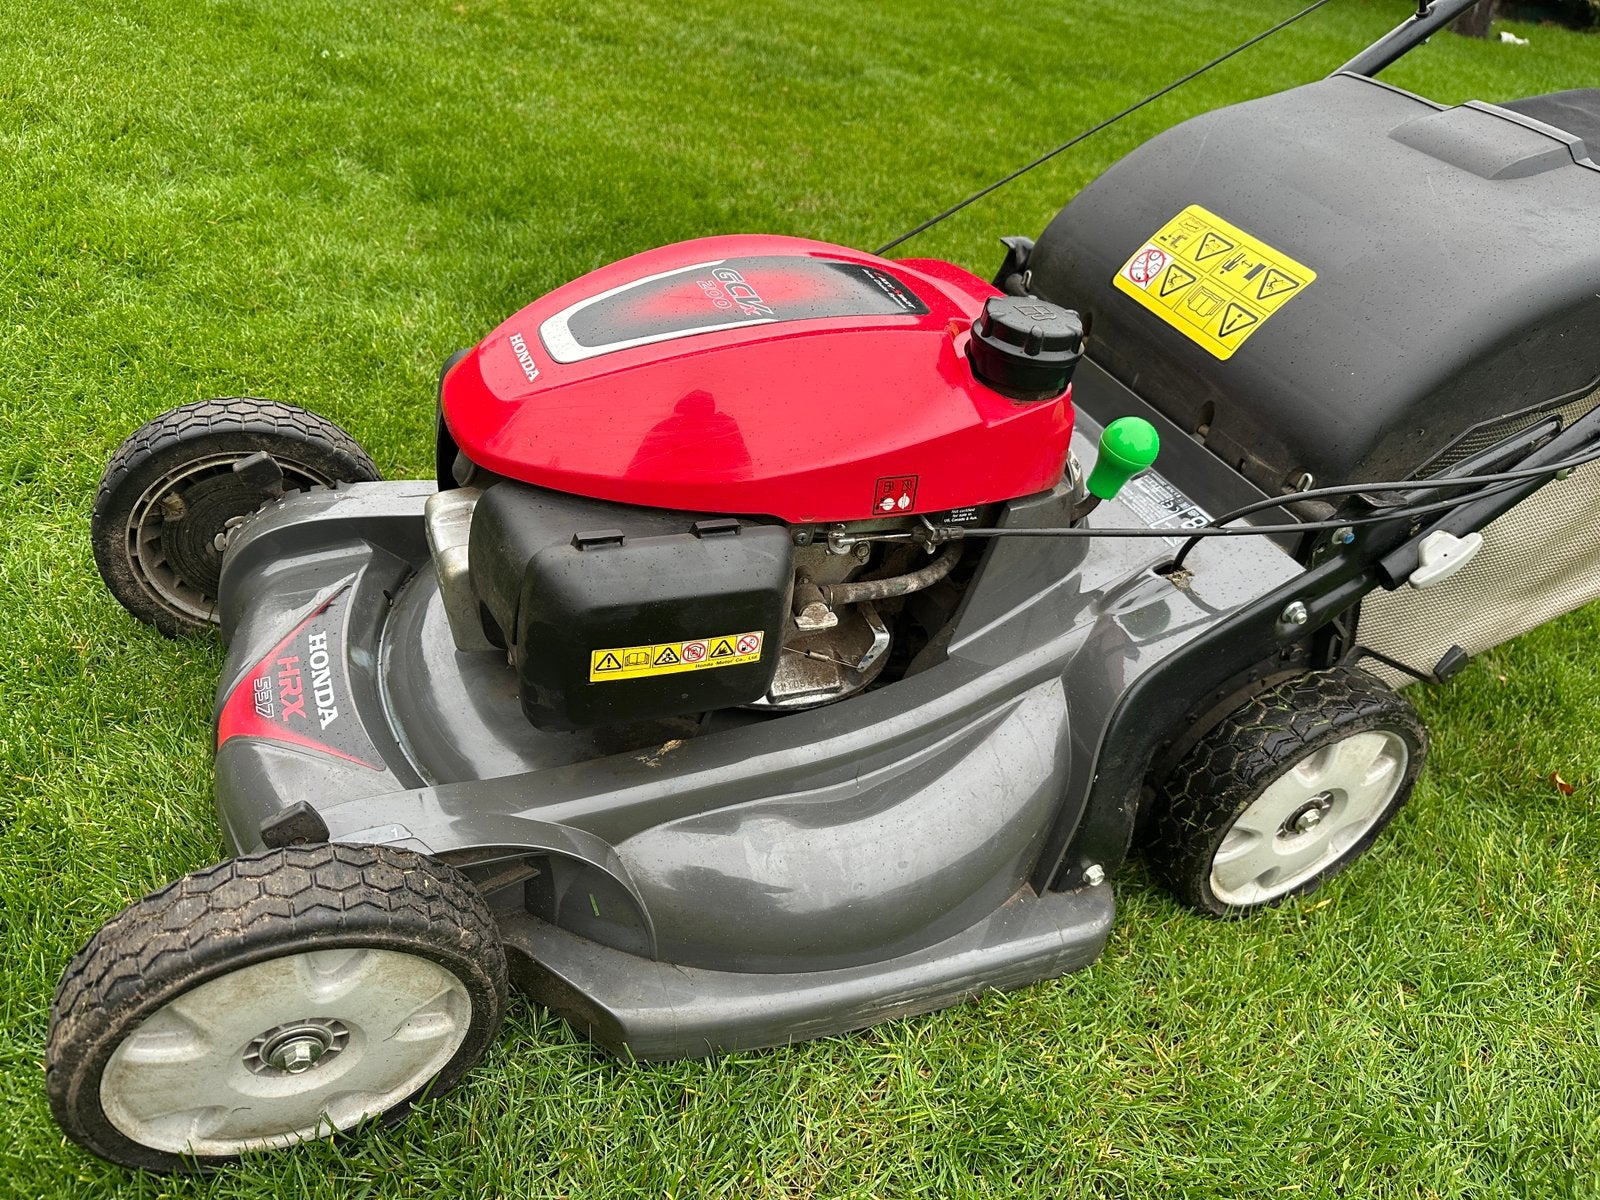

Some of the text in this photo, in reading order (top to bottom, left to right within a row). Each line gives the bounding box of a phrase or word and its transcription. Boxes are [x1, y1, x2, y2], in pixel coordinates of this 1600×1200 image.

[697, 280, 732, 308] 200
[509, 332, 540, 382] HONDA
[253, 676, 275, 718] 537
[277, 656, 307, 721] HRX
[308, 631, 339, 730] HONDA
[390, 827, 399, 838] 1
